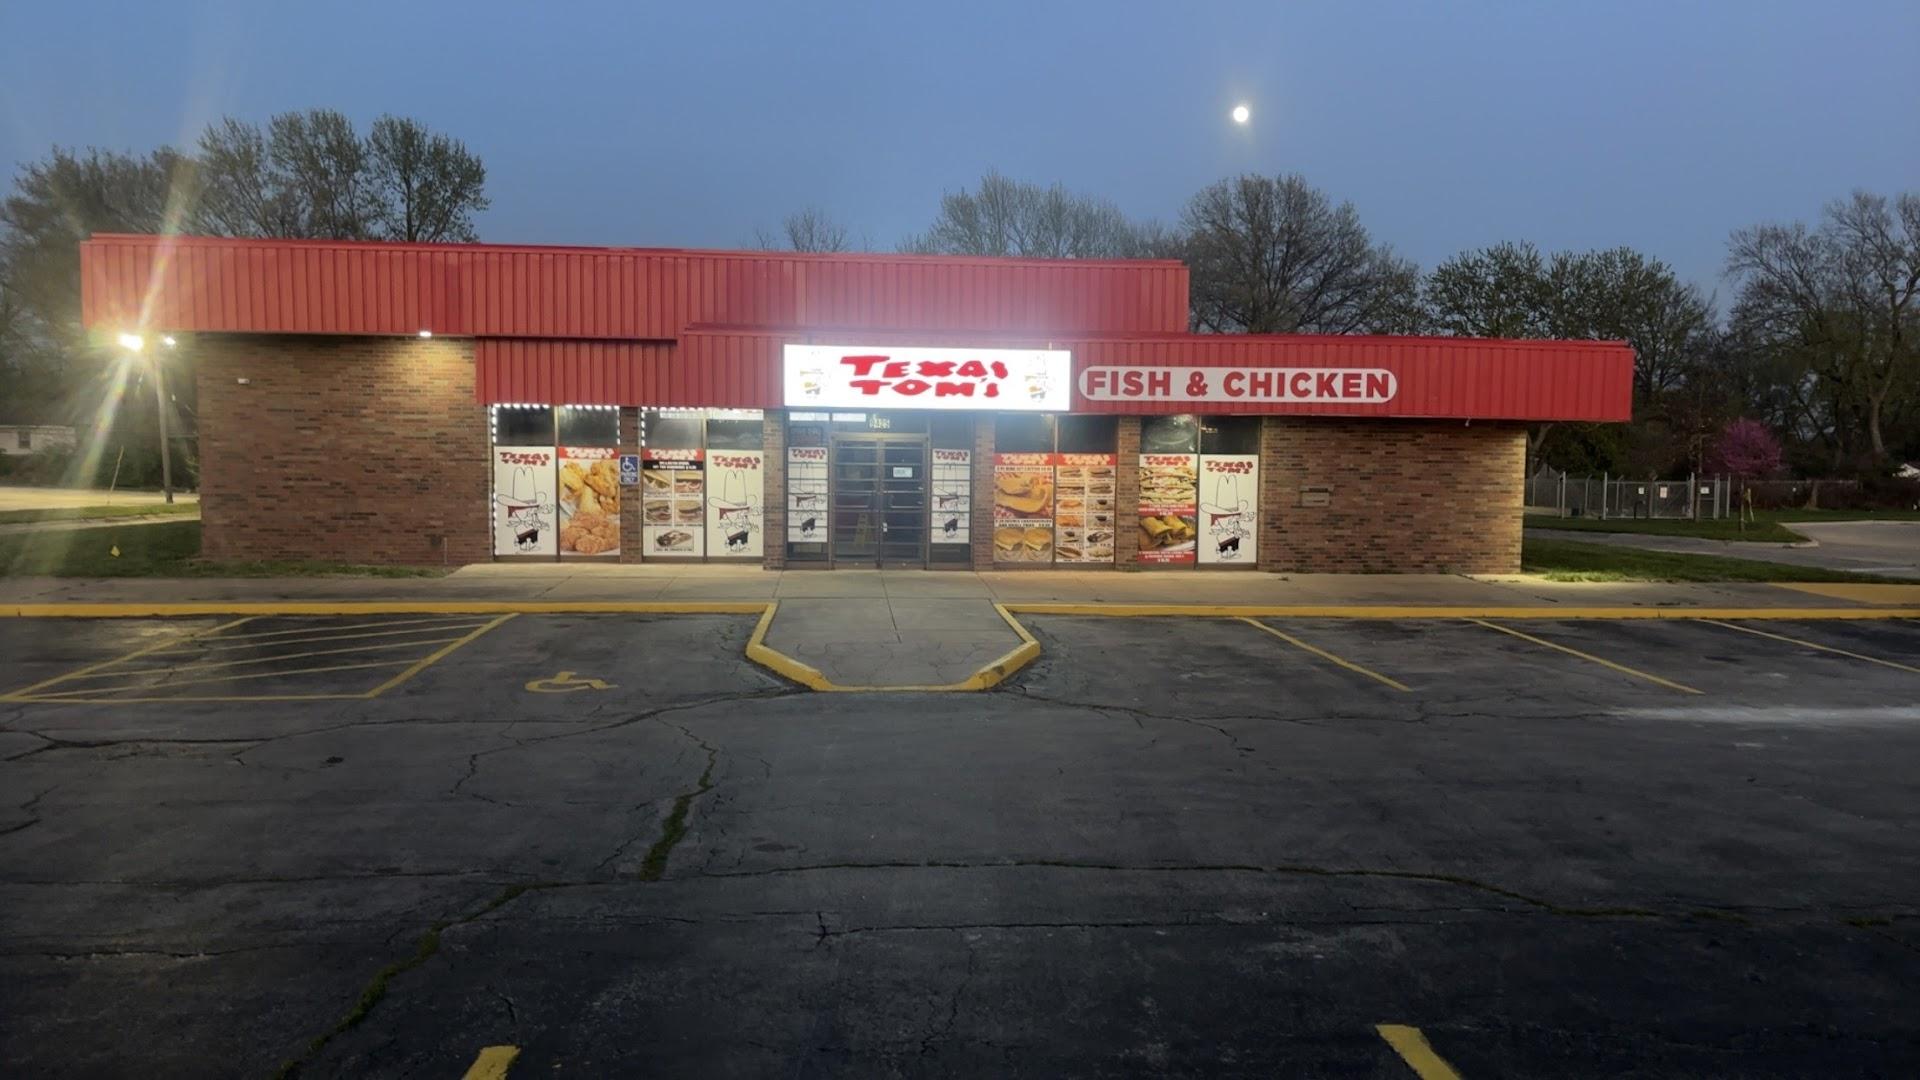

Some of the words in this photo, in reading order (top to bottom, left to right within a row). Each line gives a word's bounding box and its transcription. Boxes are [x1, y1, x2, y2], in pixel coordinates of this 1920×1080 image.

[840, 355, 1008, 379] TEXAS
[849, 378, 1000, 398] TOM'S
[1086, 371, 1171, 397] FISH
[1186, 371, 1209, 397] &
[1223, 371, 1389, 399] CHICKEN
